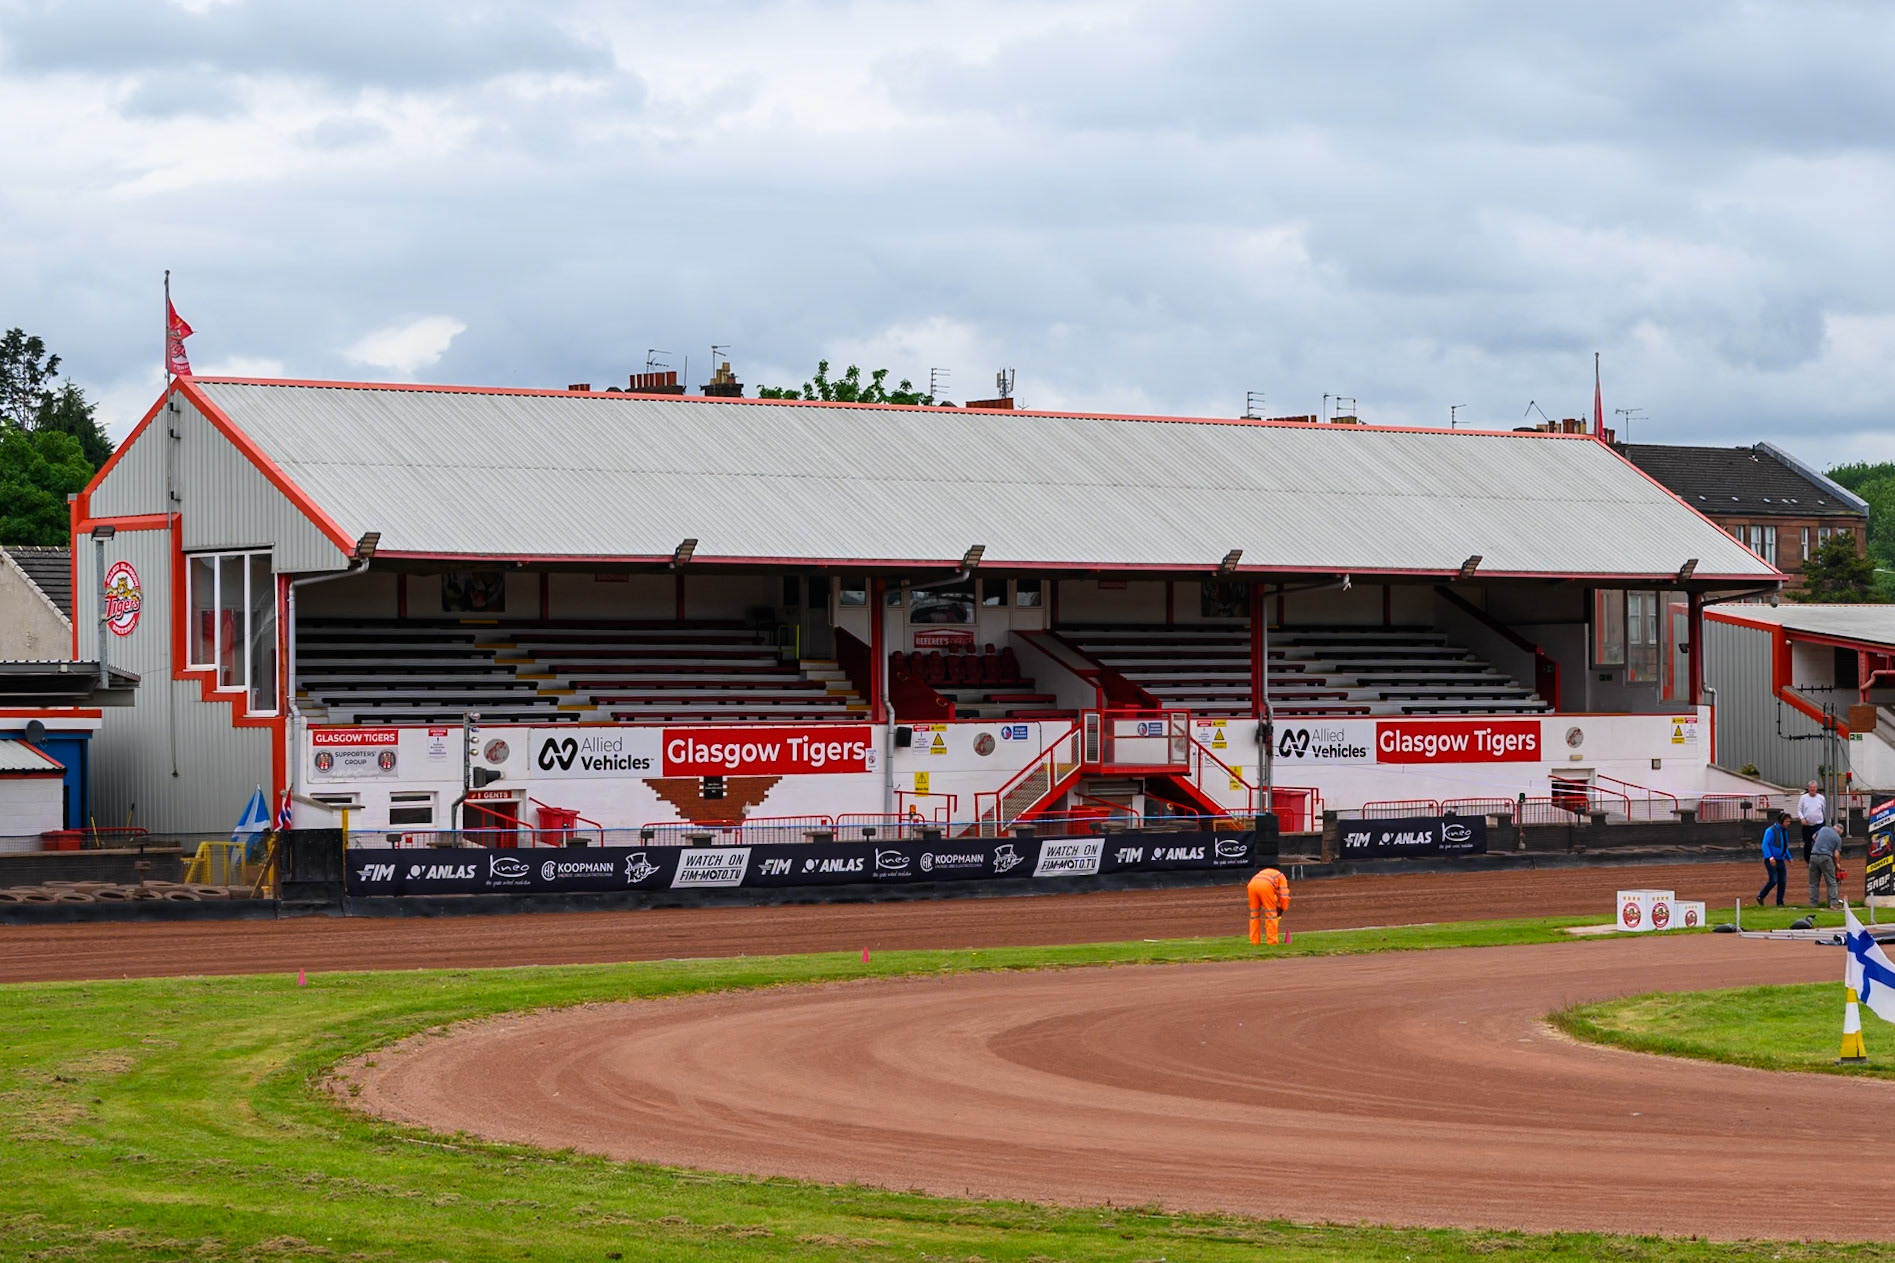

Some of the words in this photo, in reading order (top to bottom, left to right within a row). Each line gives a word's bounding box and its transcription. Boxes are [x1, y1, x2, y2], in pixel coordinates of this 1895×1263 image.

[105, 594, 141, 619] Tigers
[315, 733, 362, 743] GLASGOW
[363, 733, 395, 742] TIGERS
[1311, 727, 1345, 742] Allied
[1379, 729, 1469, 758] Glasgow
[1473, 727, 1536, 757] Tigers
[581, 736, 623, 752] Allied
[667, 737, 781, 769] Glasgow
[786, 735, 866, 767] Tigers
[1311, 743, 1367, 758] Vehicles
[334, 750, 377, 758] SUPPORTERS'
[580, 754, 651, 771] Vehicles
[483, 791, 509, 799] GENTS
[1343, 831, 1371, 848] FIM
[1393, 831, 1433, 845] ANLAS
[1441, 822, 1472, 842] Kineo
[1046, 845, 1080, 857] WATCH
[1083, 844, 1099, 856] ON
[1114, 847, 1144, 863] FIM
[1165, 846, 1206, 860] ANLAS
[1214, 837, 1248, 858] Kineo
[489, 854, 531, 878] Kineo
[685, 855, 724, 867] WATCH
[728, 854, 745, 865] ON
[758, 858, 793, 875] FIM
[819, 857, 865, 873] ANLAS
[875, 847, 911, 870] Kineo
[935, 853, 985, 864] KOOPMANN
[1041, 858, 1097, 870] FIM-MOTO.TV
[356, 863, 396, 882] FIM
[425, 864, 477, 880] ANLAS
[557, 862, 614, 873] KOOPMANN
[680, 869, 742, 881] FIM-MOTO.TV
